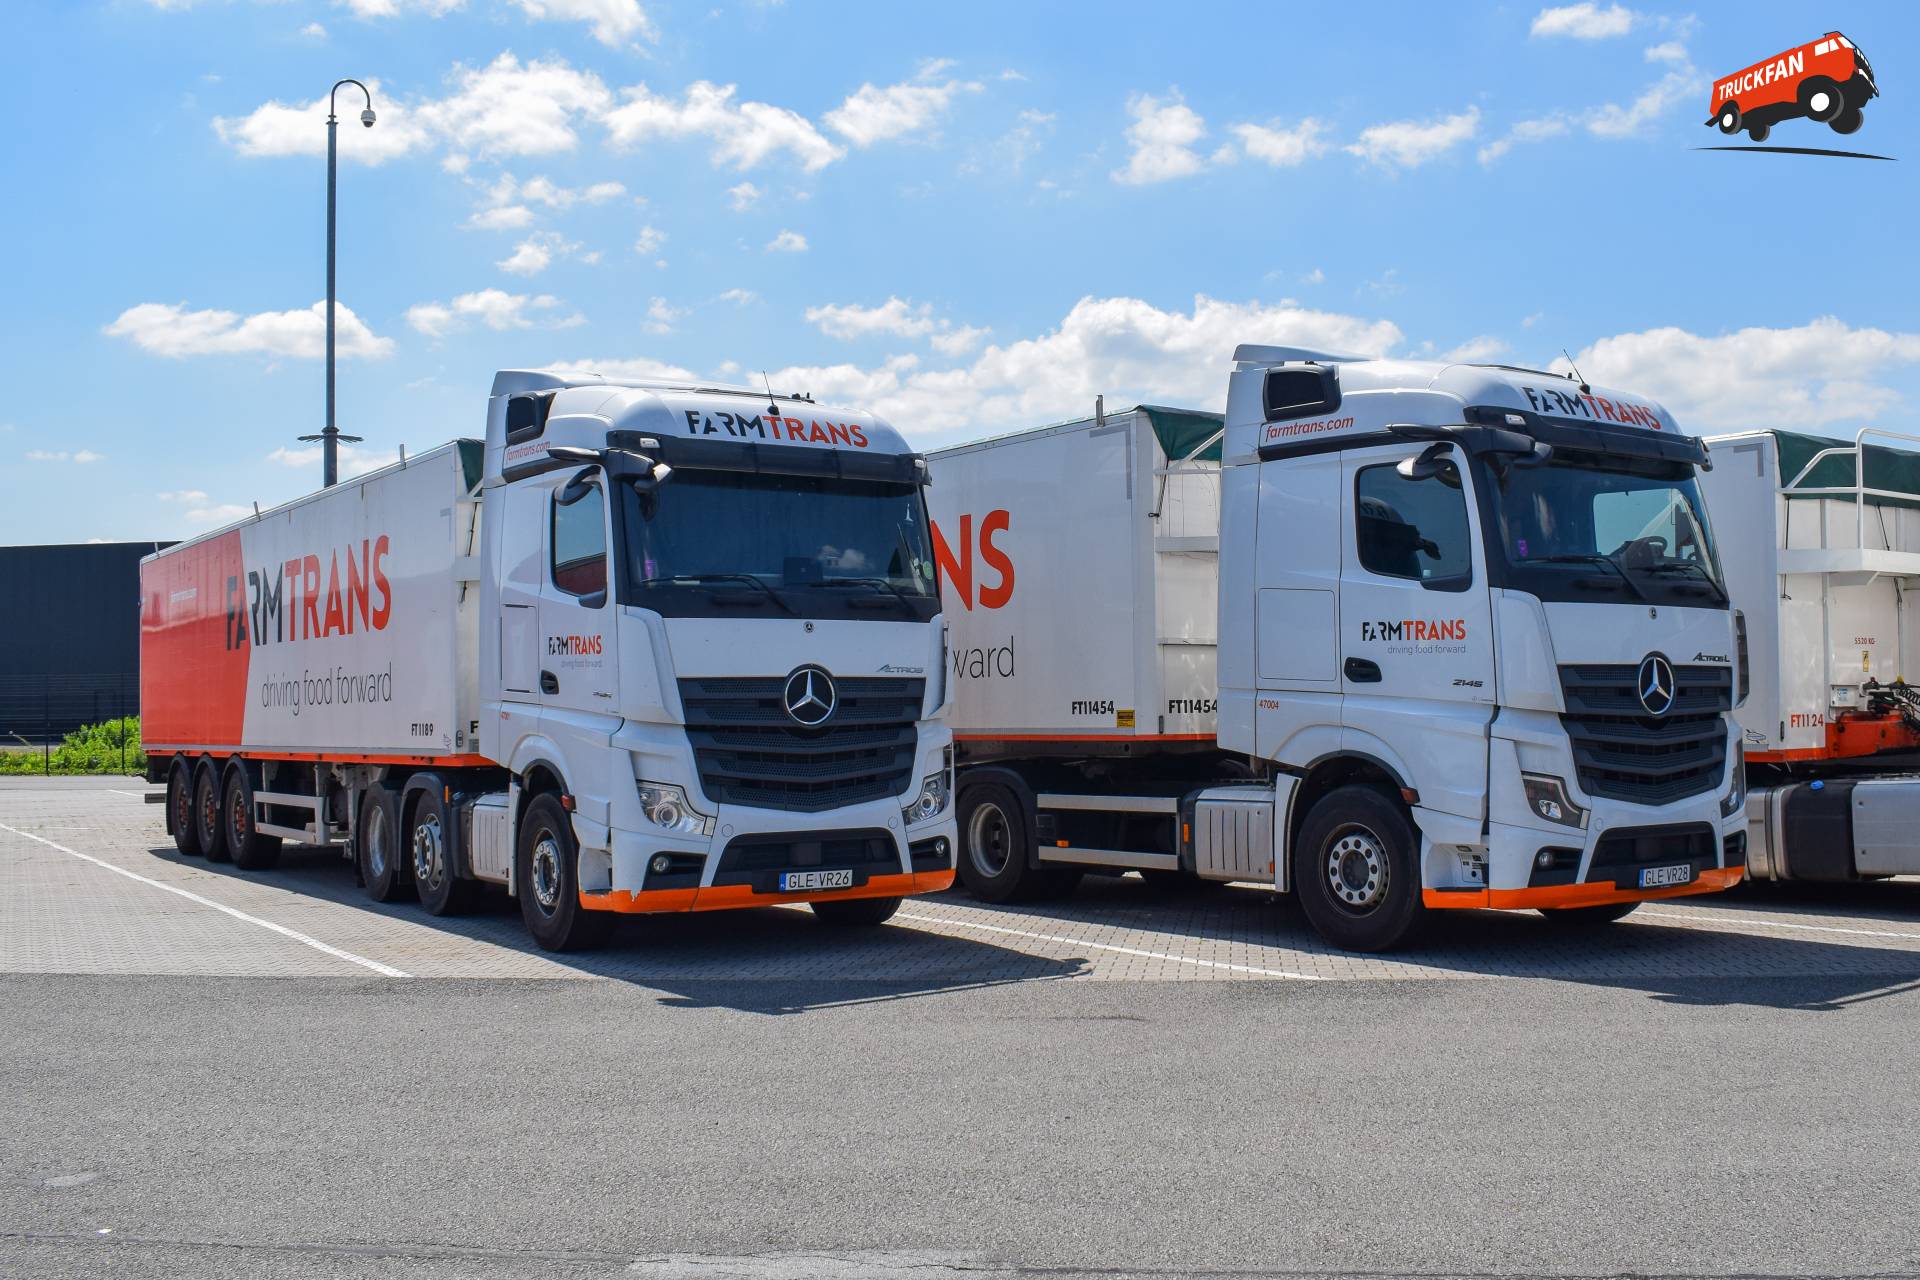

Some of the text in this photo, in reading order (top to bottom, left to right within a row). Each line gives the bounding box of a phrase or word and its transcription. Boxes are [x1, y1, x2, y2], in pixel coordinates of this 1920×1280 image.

[1521, 386, 1662, 431] FARMTRANS
[684, 409, 869, 449] FARMTRANS
[1266, 417, 1354, 443] farmtrans.com
[226, 534, 392, 651] FARMTRANS
[1362, 619, 1467, 641] FARMTRANS
[548, 634, 603, 656] FARMTRANS
[1388, 643, 1466, 656] driving food forward
[261, 661, 392, 717] driving food forward
[1071, 700, 1115, 715] FT11454
[1259, 699, 1280, 711] 47004
[411, 723, 434, 737] FT1189
[788, 871, 850, 889] GLE VR26
[1645, 866, 1688, 885] GLE VR28
